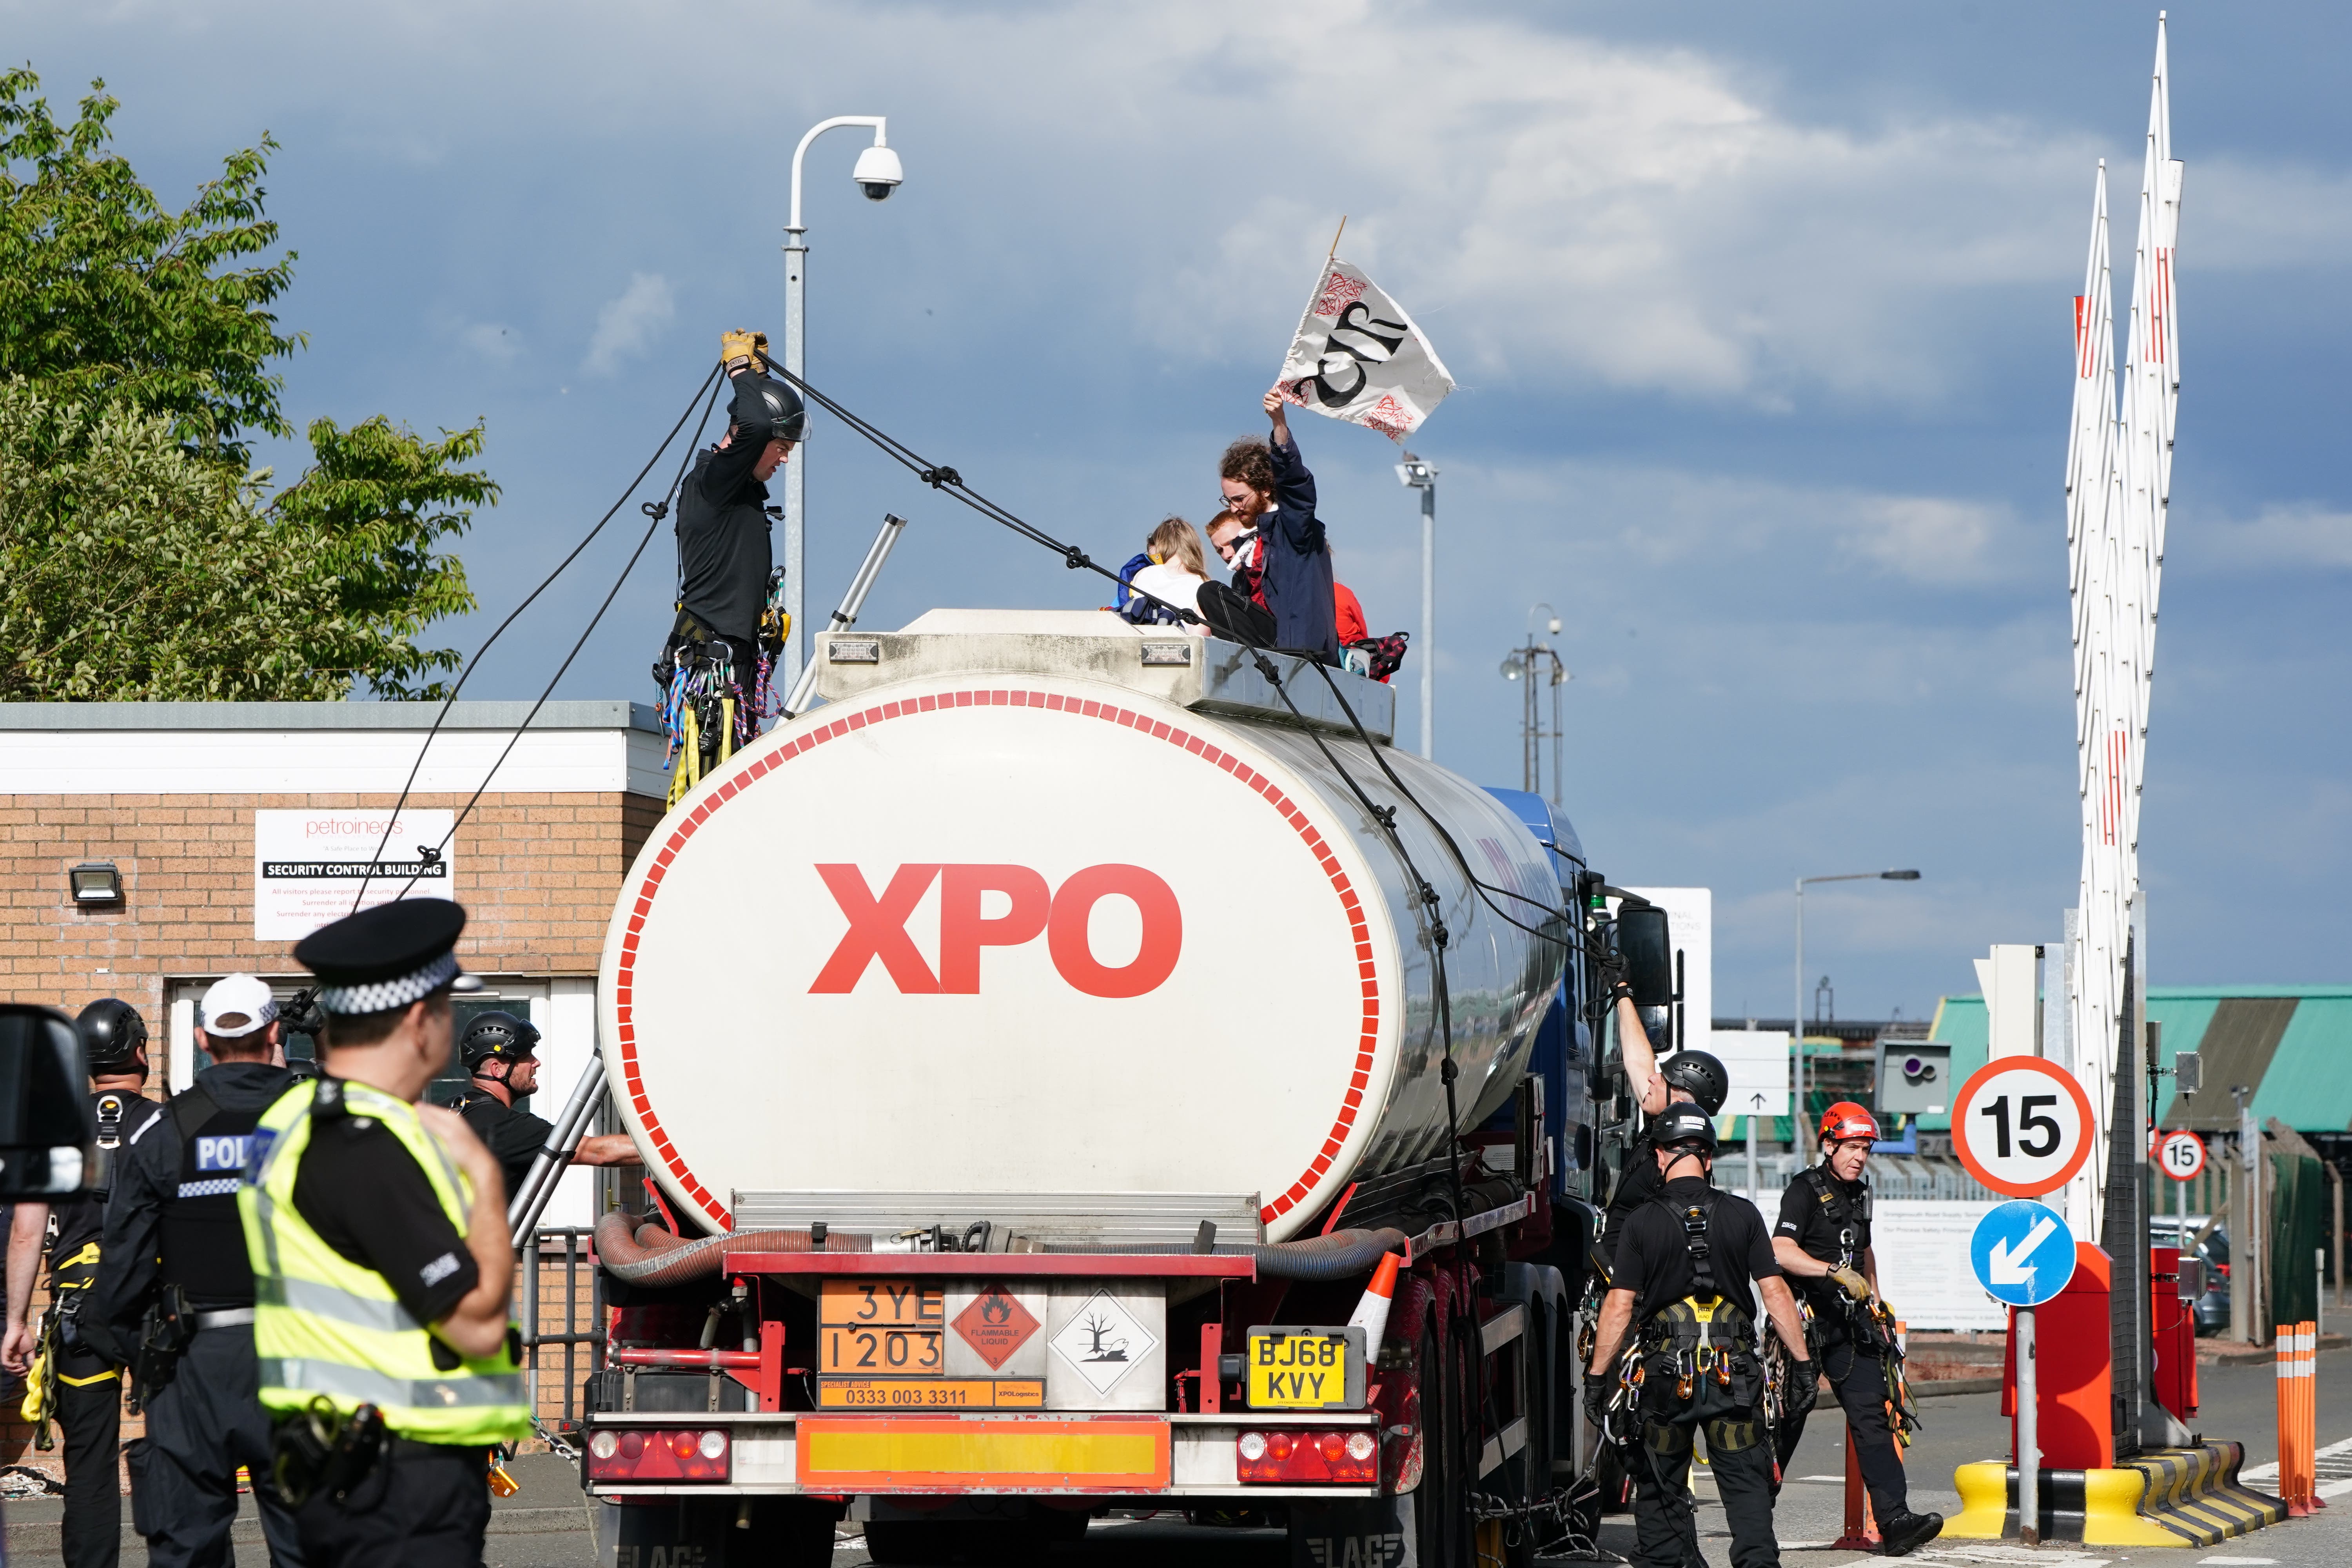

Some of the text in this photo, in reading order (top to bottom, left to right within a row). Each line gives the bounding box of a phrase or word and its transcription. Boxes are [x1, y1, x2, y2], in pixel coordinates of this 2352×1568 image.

[307, 817, 403, 838] petroineos
[268, 865, 324, 875] SECURITY
[326, 865, 382, 875] CONTROL
[807, 864, 1182, 998] XPO
[1981, 1095, 2061, 1158] 15
[2169, 1146, 2194, 1166] 15
[857, 1286, 942, 1319] 3YE
[833, 1333, 939, 1367] 1203
[1259, 1340, 1336, 1367] BJ68
[846, 1390, 966, 1405] 0333 003 3311
[1269, 1372, 1325, 1399] KVY
[1325, 1534, 1383, 1568] LAG
